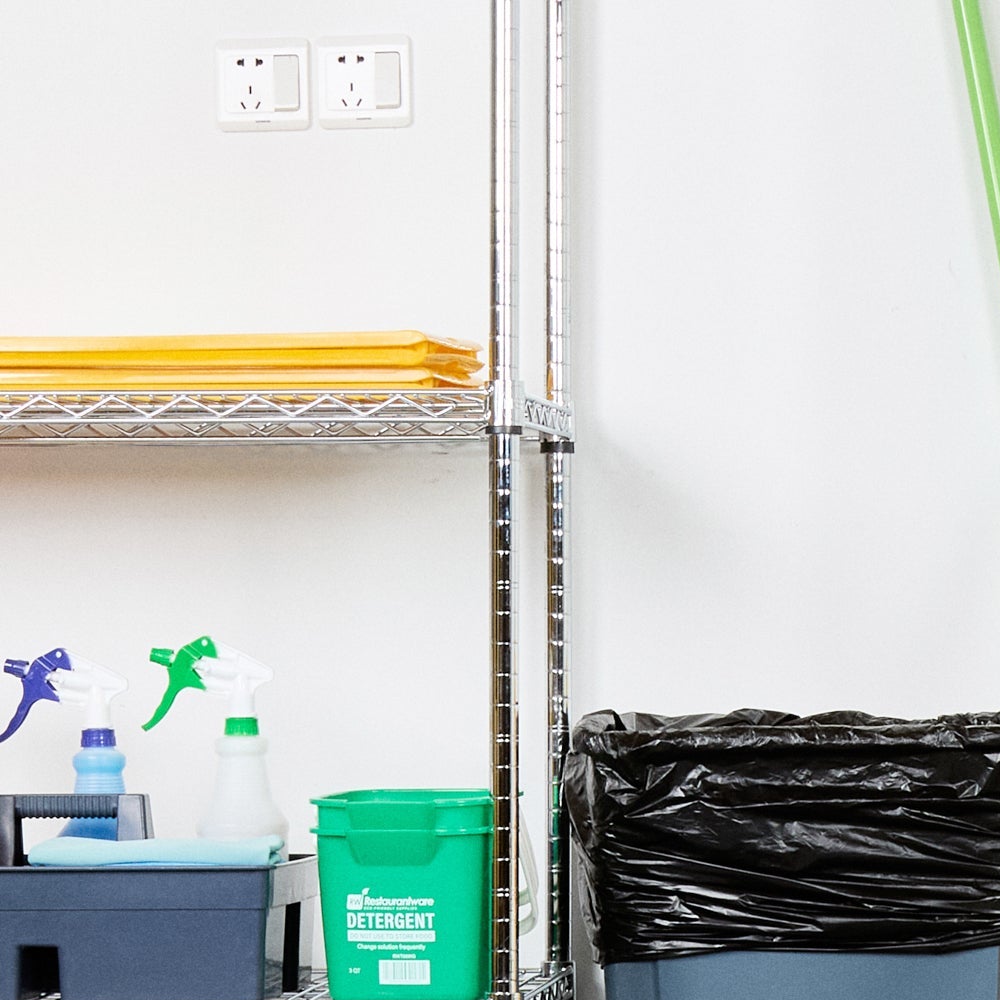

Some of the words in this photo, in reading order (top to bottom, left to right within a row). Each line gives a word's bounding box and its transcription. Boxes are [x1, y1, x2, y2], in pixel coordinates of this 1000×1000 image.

[363, 896, 434, 906] Restaurantware
[347, 912, 435, 929] DETERGENT
[357, 943, 377, 951] Change
[377, 943, 399, 951] solution
[399, 943, 426, 951] frequently
